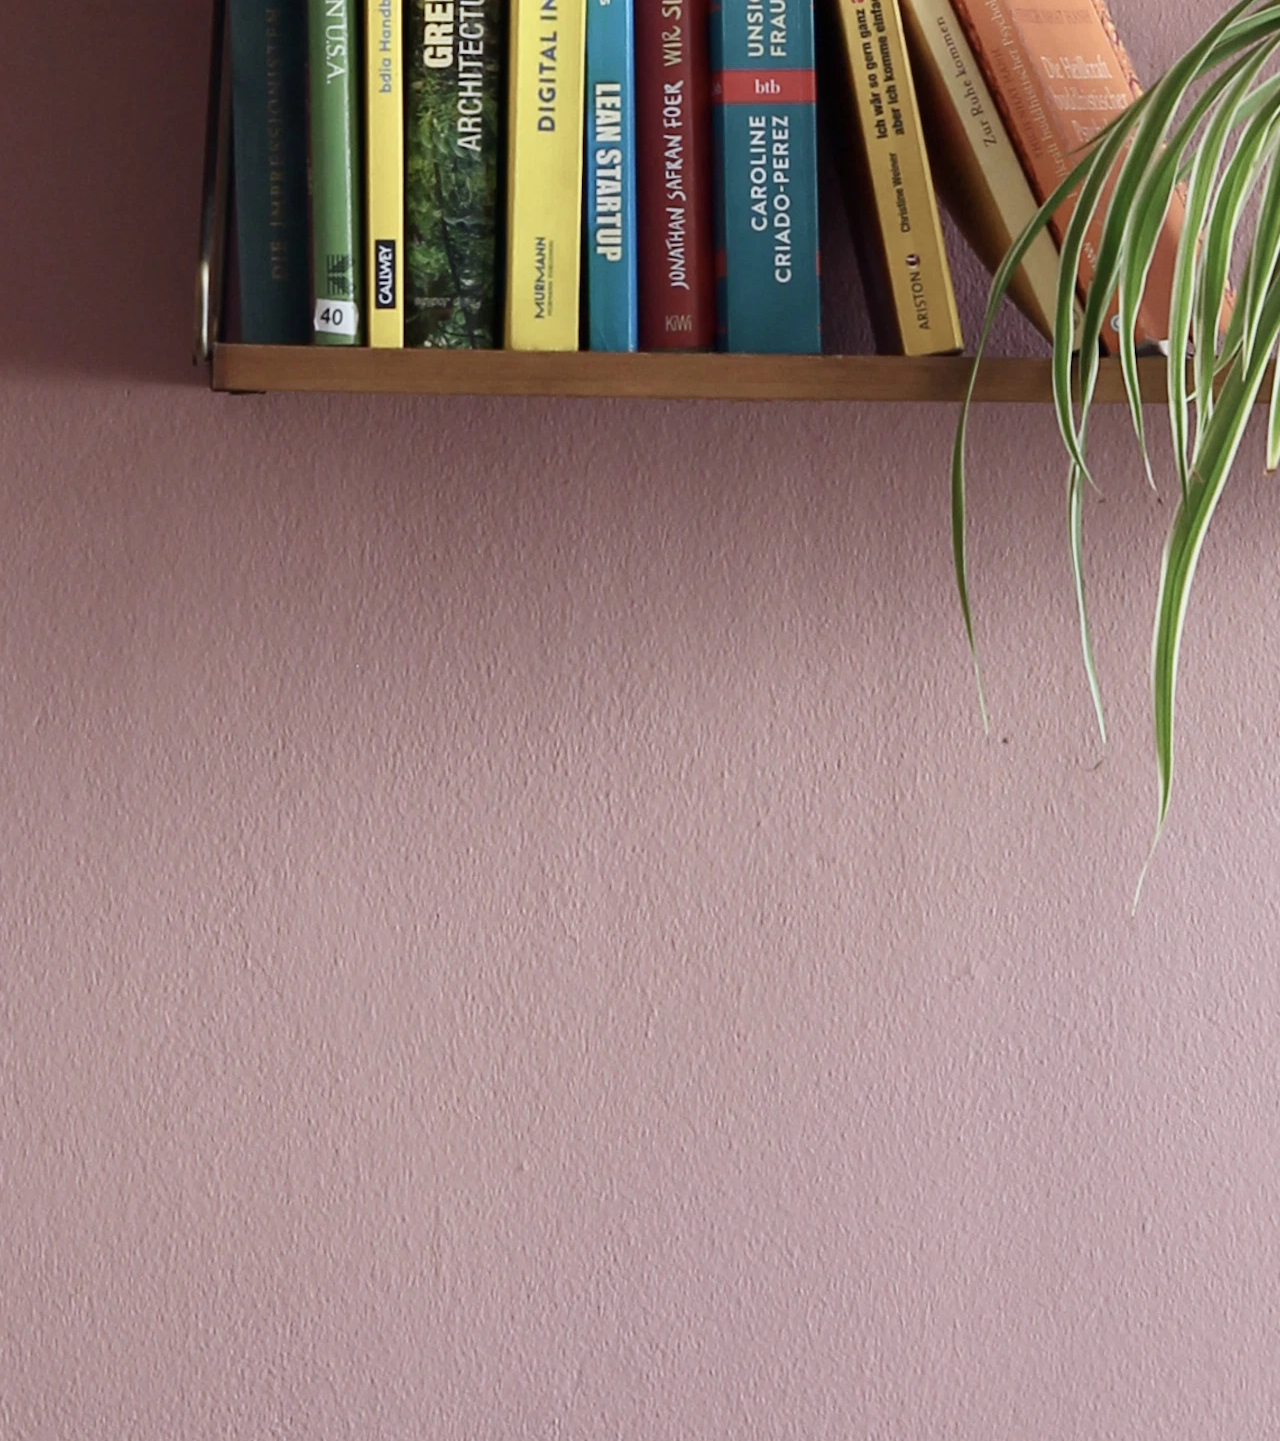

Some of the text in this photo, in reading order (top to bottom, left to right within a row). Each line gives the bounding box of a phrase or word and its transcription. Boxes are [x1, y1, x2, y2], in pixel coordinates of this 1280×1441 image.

[662, 27, 683, 67] WIR
[856, 8, 872, 38] ganz
[379, 58, 392, 94] bdia
[537, 30, 556, 132] DIGITAL
[862, 42, 878, 70] gern
[868, 73, 878, 88] so
[878, 36, 894, 82] komme
[936, 16, 997, 147] Zur Ruhe kommen
[663, 79, 684, 129] FOER
[755, 79, 780, 94] btb
[869, 92, 883, 116] wär
[1009, 45, 1053, 141] buddhistischer
[891, 108, 905, 135] aber
[595, 82, 622, 262] LEAN STARTUP
[664, 134, 686, 202] SAFRAN
[749, 116, 767, 231] CAROLINE
[889, 152, 911, 233] Christine Weiner
[772, 116, 792, 283] CRIADO-PEREZ
[378, 245, 394, 305] CALLWEY
[534, 236, 546, 319] MURMANN
[666, 207, 690, 290] JONATHAN
[320, 307, 343, 326] 40
[909, 272, 931, 330] ARISTON
